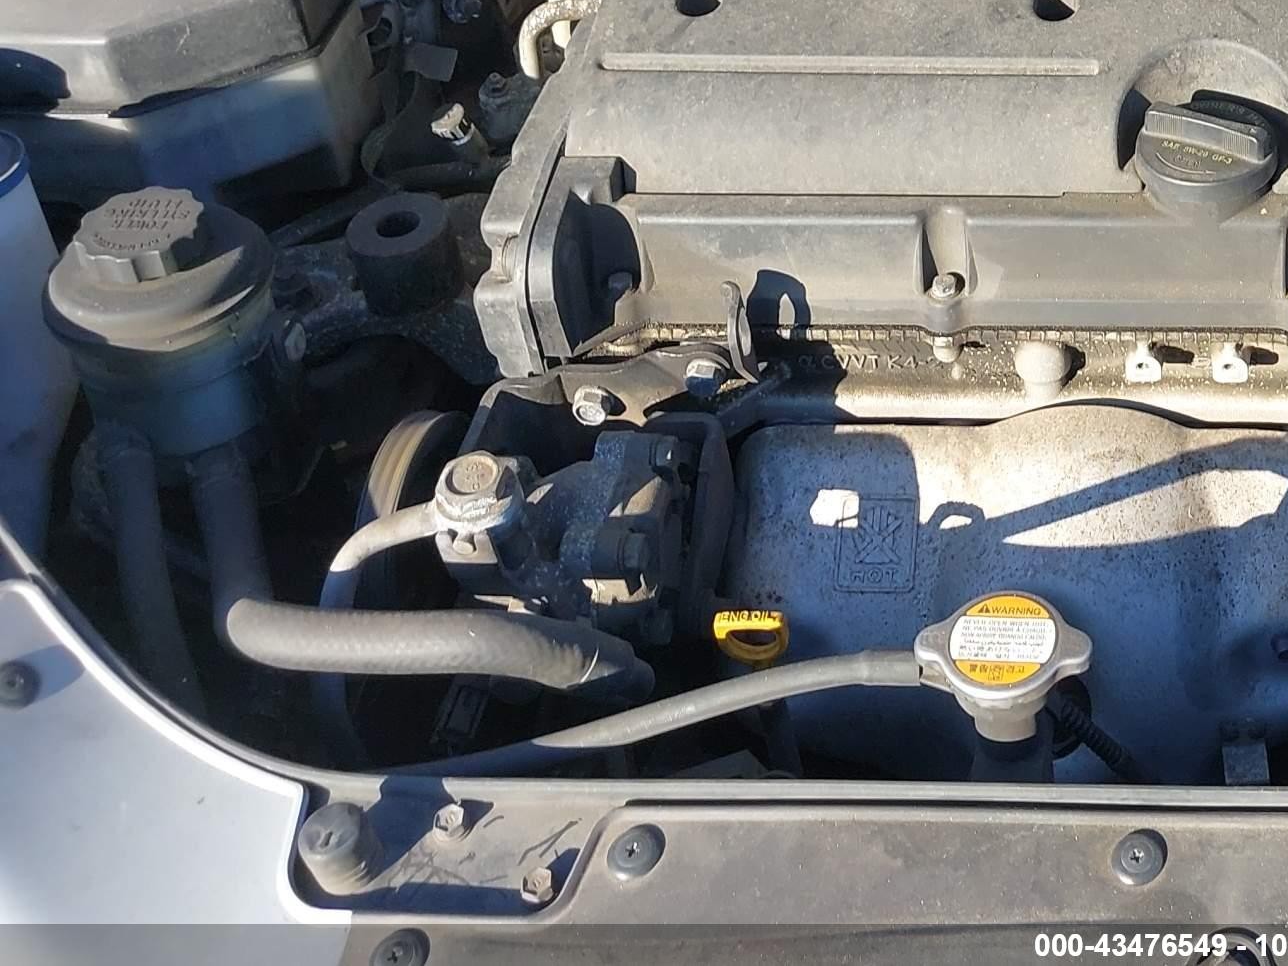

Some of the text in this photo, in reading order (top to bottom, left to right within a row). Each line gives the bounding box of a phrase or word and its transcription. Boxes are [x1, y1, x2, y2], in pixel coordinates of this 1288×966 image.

[821, 354, 880, 370] CVVT
[719, 610, 777, 622] ENG OIL
[992, 606, 1042, 616] WARNING
